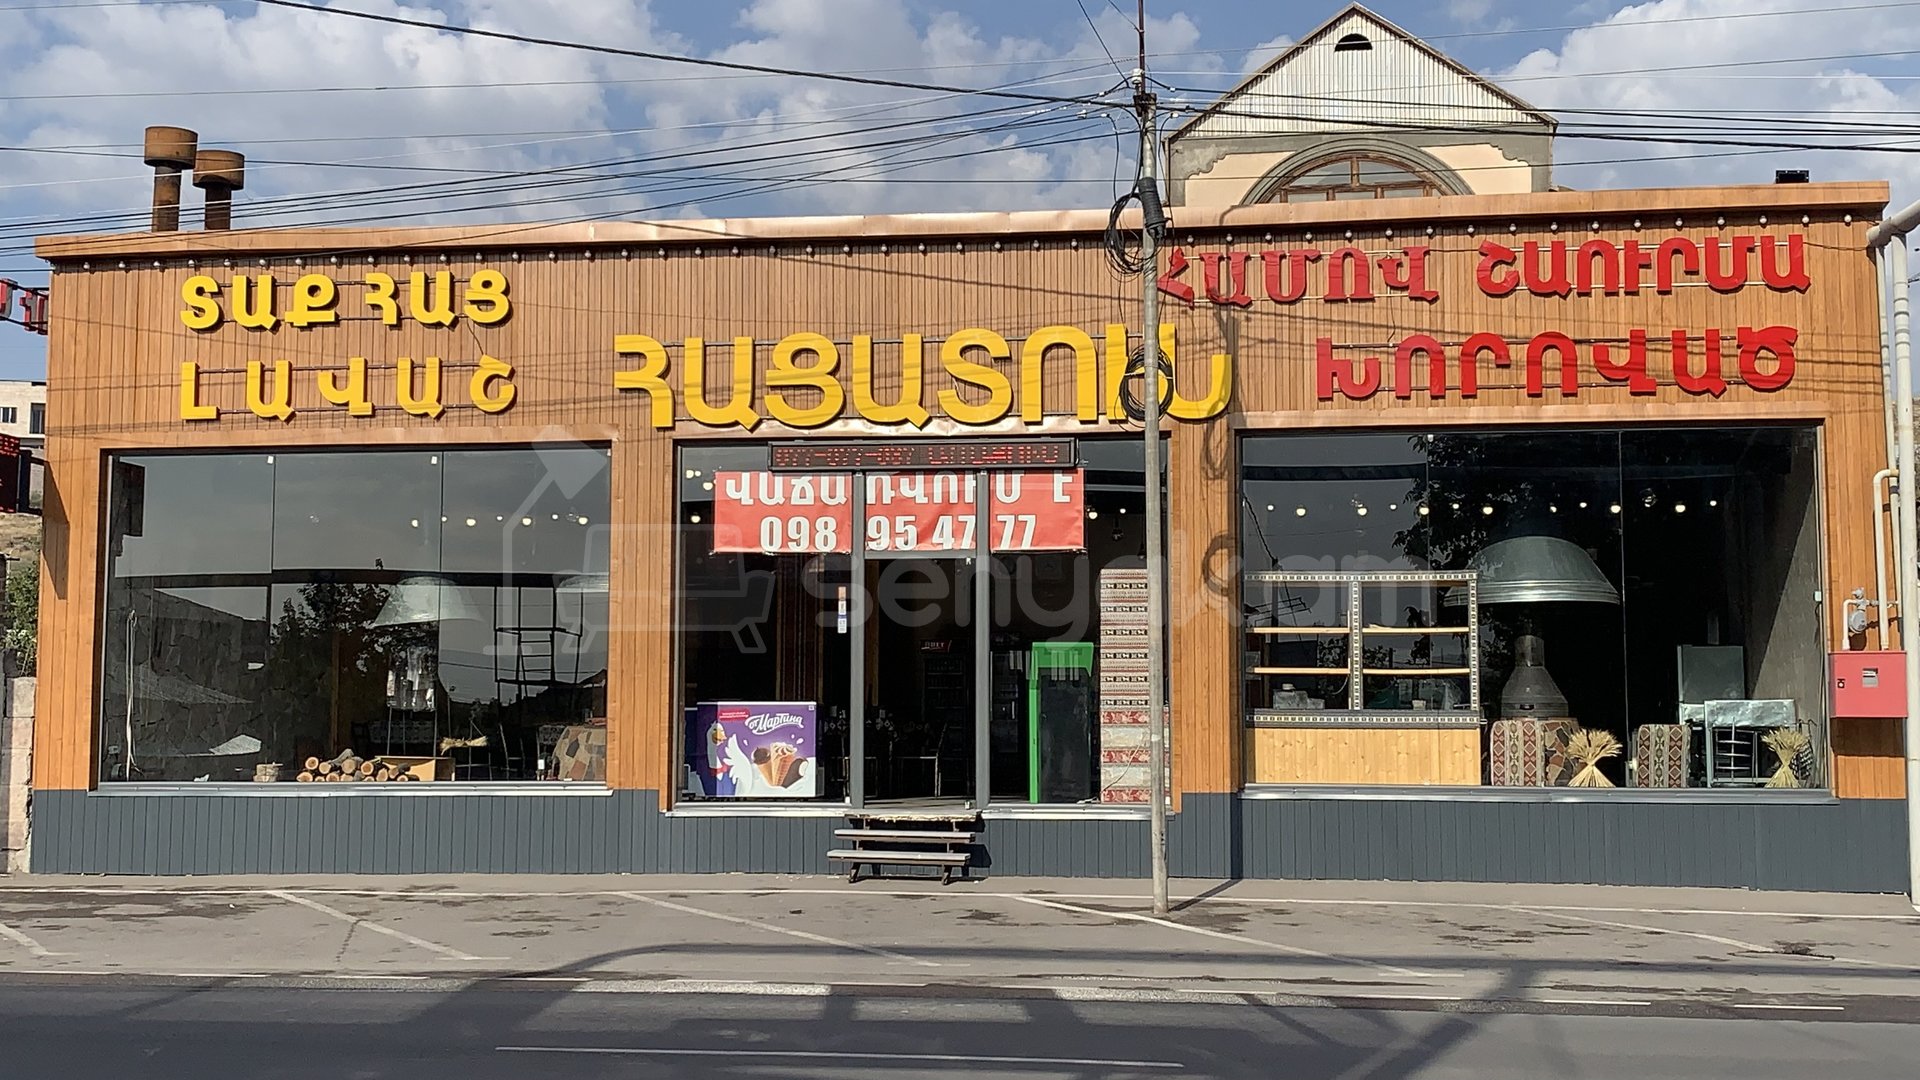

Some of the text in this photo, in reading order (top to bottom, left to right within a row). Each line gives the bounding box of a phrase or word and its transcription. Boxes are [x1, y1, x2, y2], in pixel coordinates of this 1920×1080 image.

[180, 269, 510, 330] ՏԱՔ ՀԱՑ
[1157, 234, 1811, 308] ՀԱՄՈՎ ՇԱՈՒՐՄԱ
[180, 354, 516, 422] ԼԱՎԱՇ
[614, 322, 1233, 431] ՀԱՑԱՏՈՒՆ
[1316, 326, 1799, 399] ԽՈՐՈՎԱԾ
[760, 514, 1037, 552] 098 95 47 77
